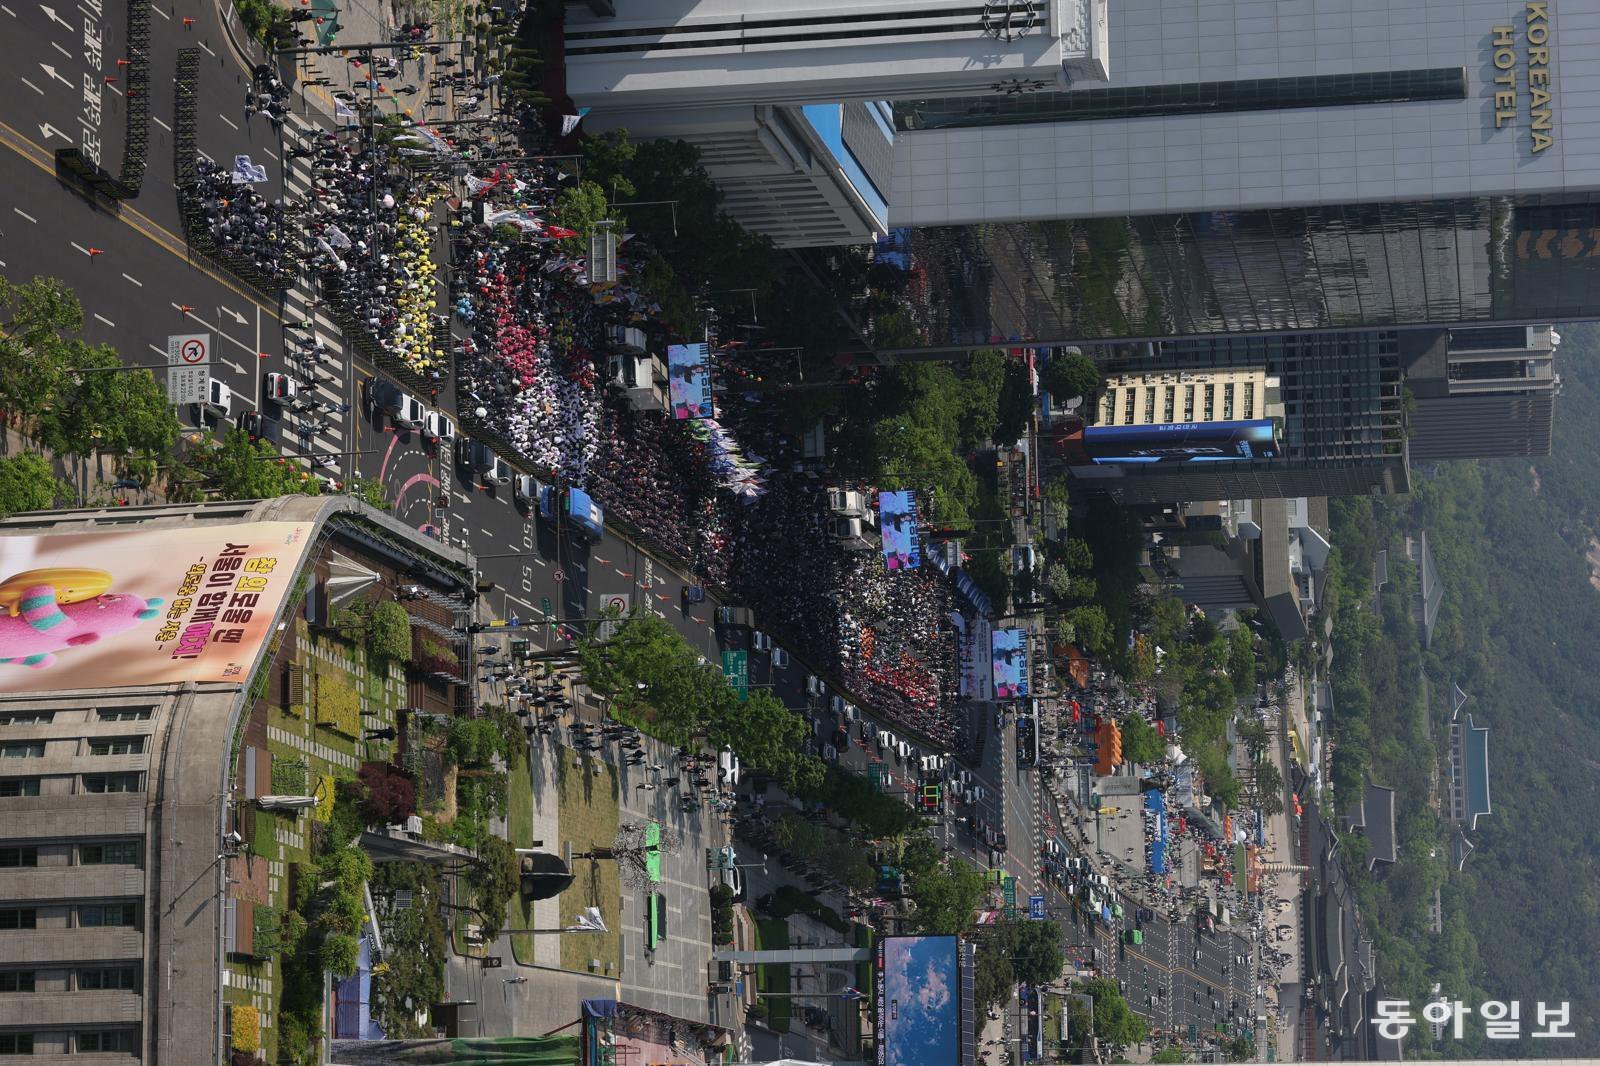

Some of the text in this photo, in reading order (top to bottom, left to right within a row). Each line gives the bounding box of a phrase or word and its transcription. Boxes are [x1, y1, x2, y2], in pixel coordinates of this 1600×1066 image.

[84, 17, 102, 72] 숭례문
[1492, 26, 1517, 128] HOTEL
[1526, 2, 1554, 153] KOREANA
[83, 72, 102, 126] 숭례문
[83, 128, 101, 168] 공로
[523, 523, 533, 550] 50
[205, 543, 249, 588] 서울이
[244, 557, 278, 574] 참
[522, 565, 532, 592] 50
[166, 597, 194, 619] 없는
[220, 576, 268, 624] 외로울
[155, 621, 181, 642] 서울
[212, 628, 245, 644] 땐
